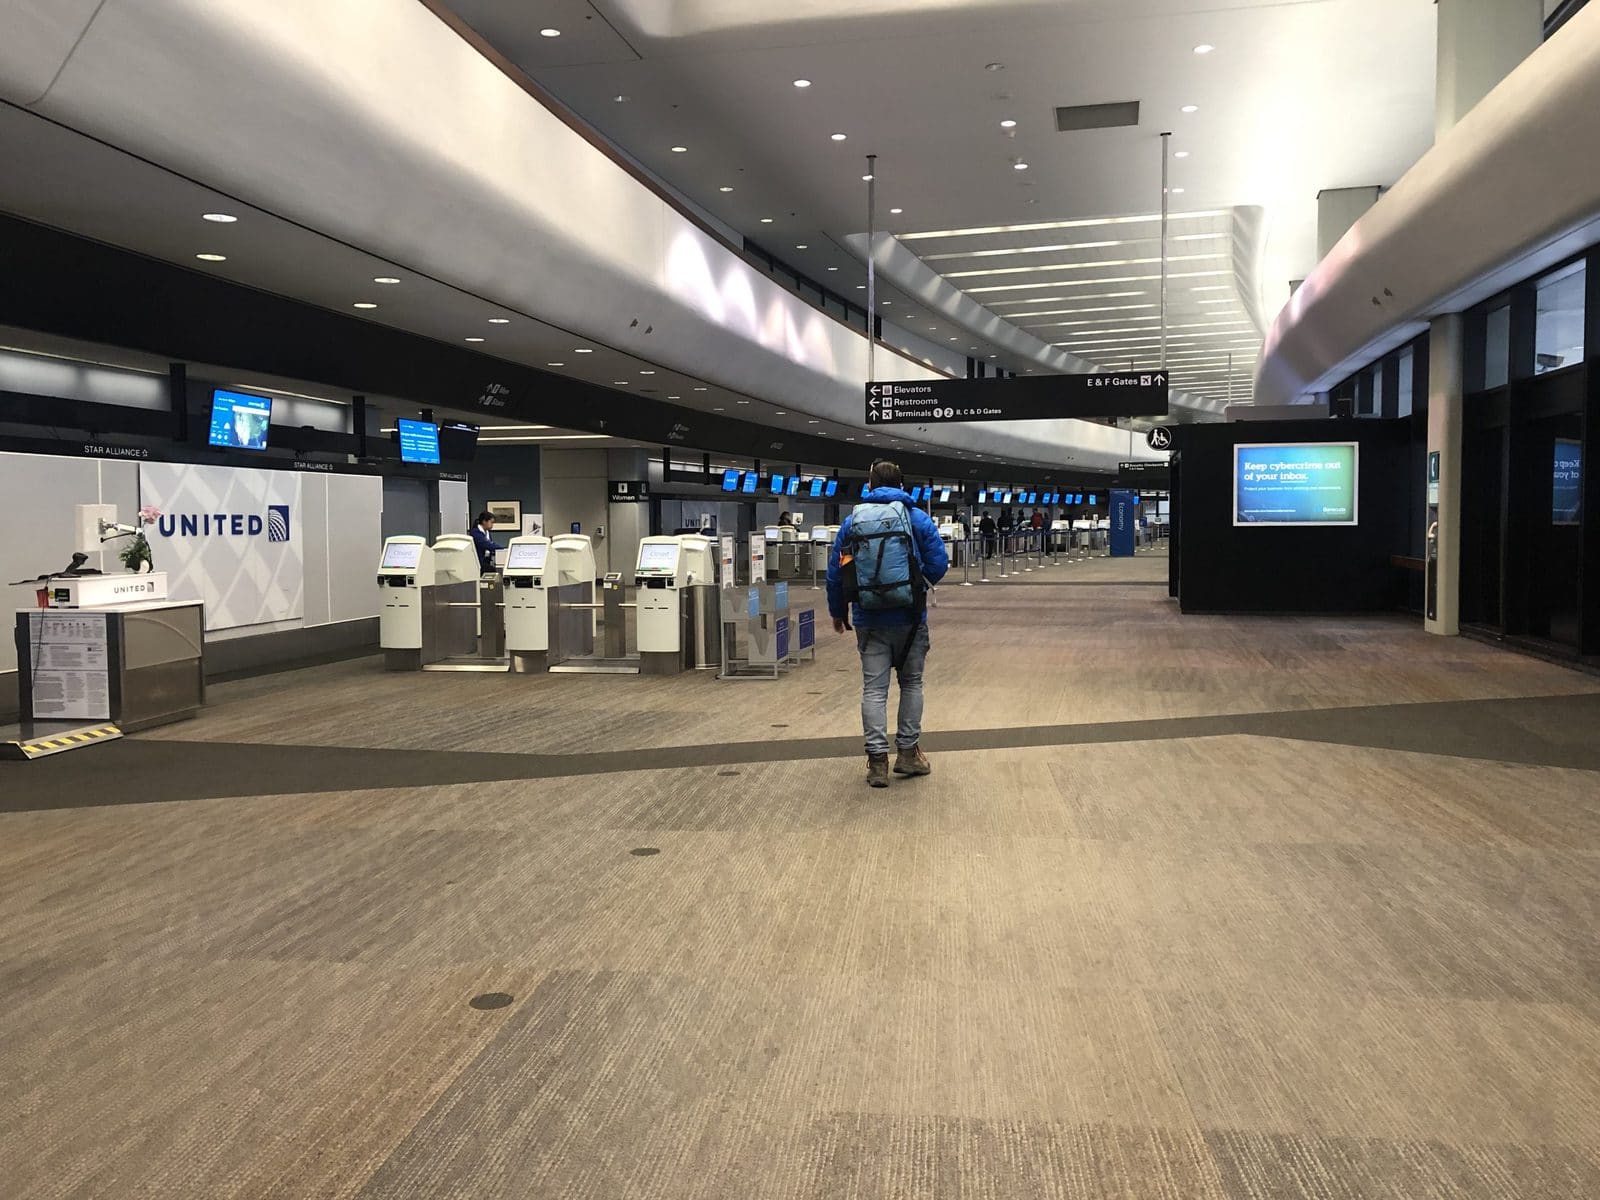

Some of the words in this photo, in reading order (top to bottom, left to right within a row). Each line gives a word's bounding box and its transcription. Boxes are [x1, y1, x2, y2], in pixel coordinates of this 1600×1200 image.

[1087, 378, 1093, 387] E
[1095, 378, 1102, 387] &
[1104, 378, 1110, 386] F
[1112, 377, 1138, 386] Gates
[894, 386, 932, 394] Elevators
[894, 398, 938, 406] Restrooms
[894, 409, 932, 417] Terminals
[84, 445, 104, 454] STAR
[105, 447, 140, 457] ALLIANCE
[306, 462, 328, 470] ALLIANCE
[1244, 462, 1267, 471] Keep
[1269, 462, 1322, 471] cybercrime
[1255, 473, 1278, 481] your
[1280, 472, 1309, 480] inbox.
[158, 514, 263, 537] UNITED
[114, 584, 146, 594] UNITED
